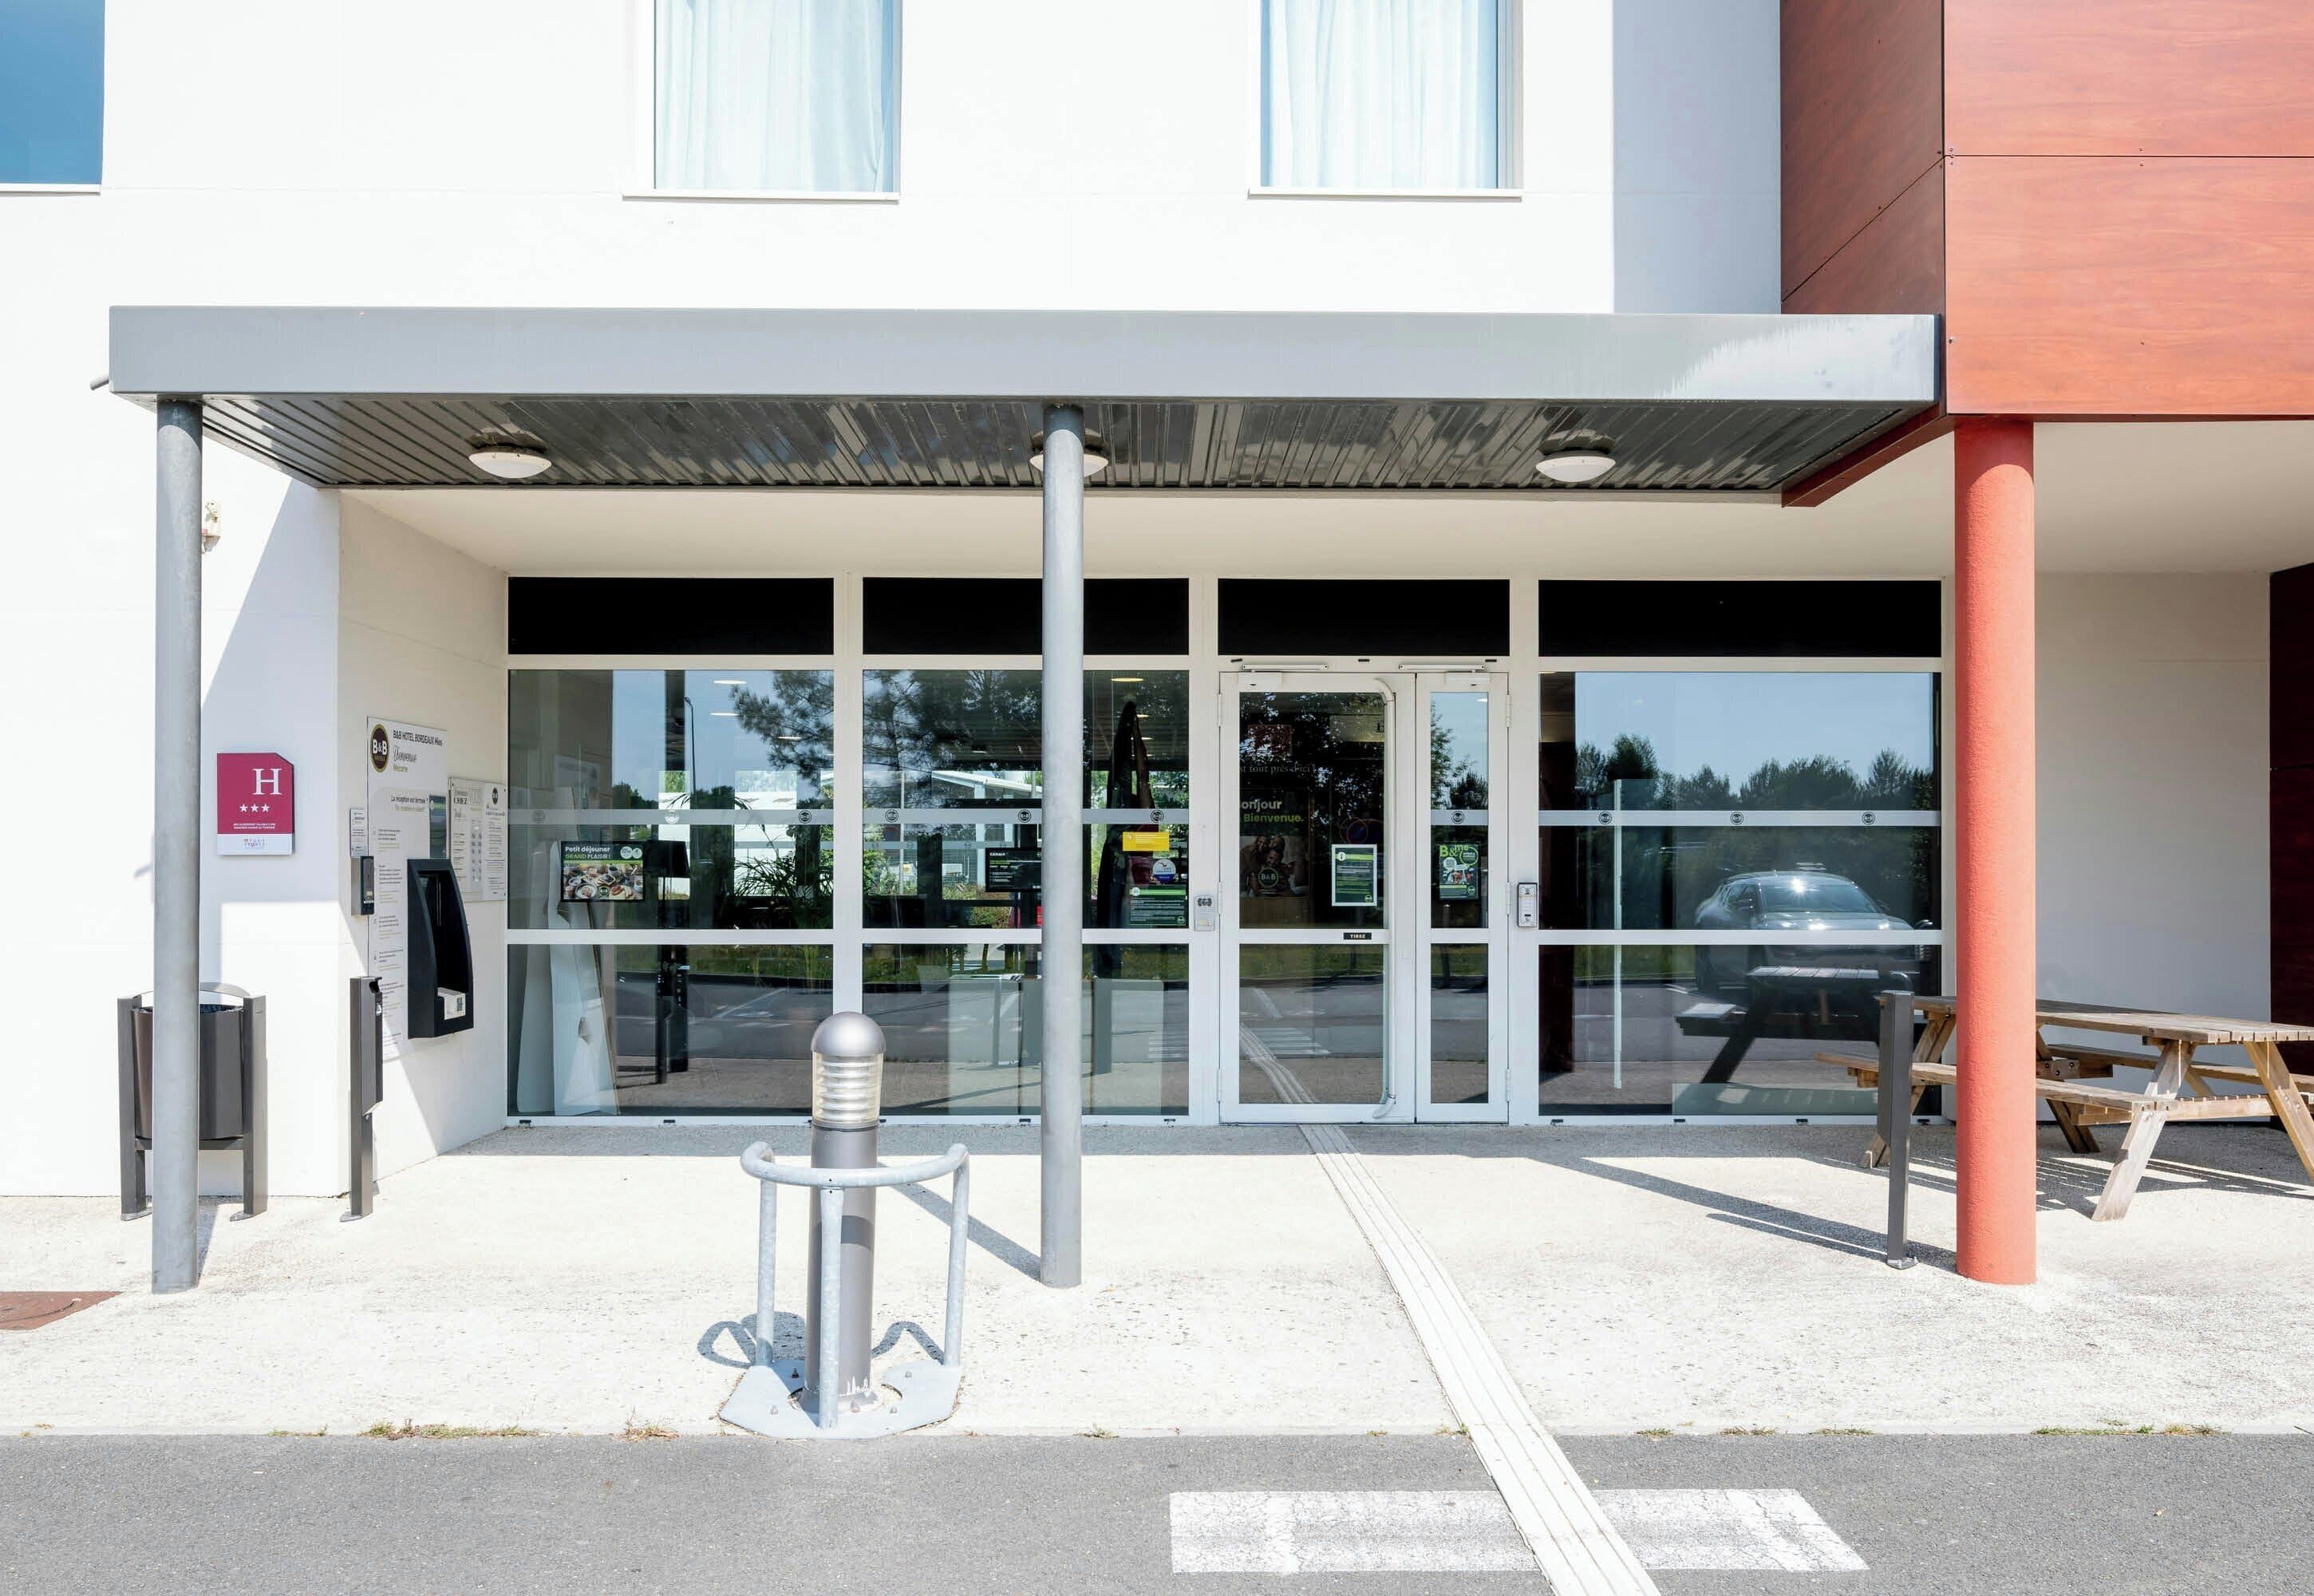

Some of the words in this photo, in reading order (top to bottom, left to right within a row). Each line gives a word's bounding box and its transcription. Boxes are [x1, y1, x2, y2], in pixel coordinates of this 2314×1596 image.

[373, 739, 388, 756] B&B
[252, 768, 282, 795] H
[1240, 800, 1282, 812] onjour
[581, 845, 610, 854] déjeuner
